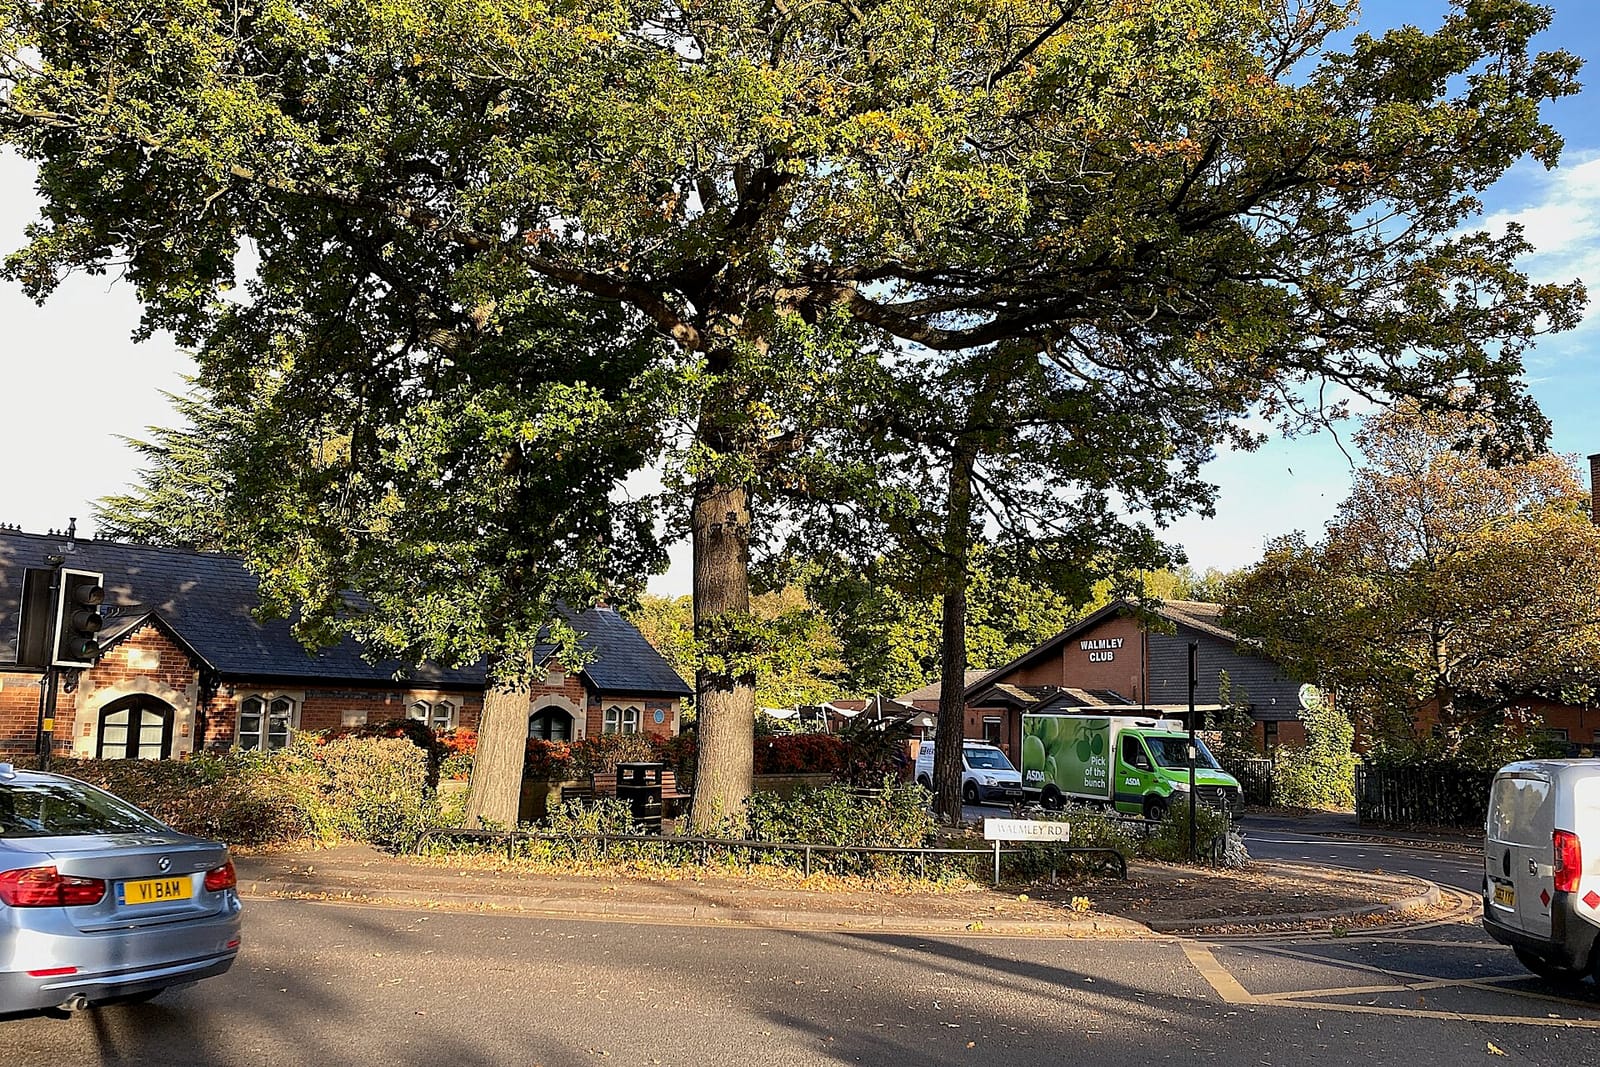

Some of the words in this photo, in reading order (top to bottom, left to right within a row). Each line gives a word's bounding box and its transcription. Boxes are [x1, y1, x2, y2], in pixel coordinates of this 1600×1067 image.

[1080, 638, 1123, 650] WALMLEY
[1089, 651, 1114, 662] CLUB
[1090, 756, 1106, 767] Pick
[1026, 769, 1046, 783] ASDA
[1084, 767, 1093, 777] of
[1094, 767, 1106, 778] the
[1084, 777, 1106, 789] bunch
[1125, 777, 1141, 787] ASDA
[997, 823, 1047, 835] WALMLEY
[1047, 825, 1063, 836] RD
[155, 880, 181, 898] BAM
